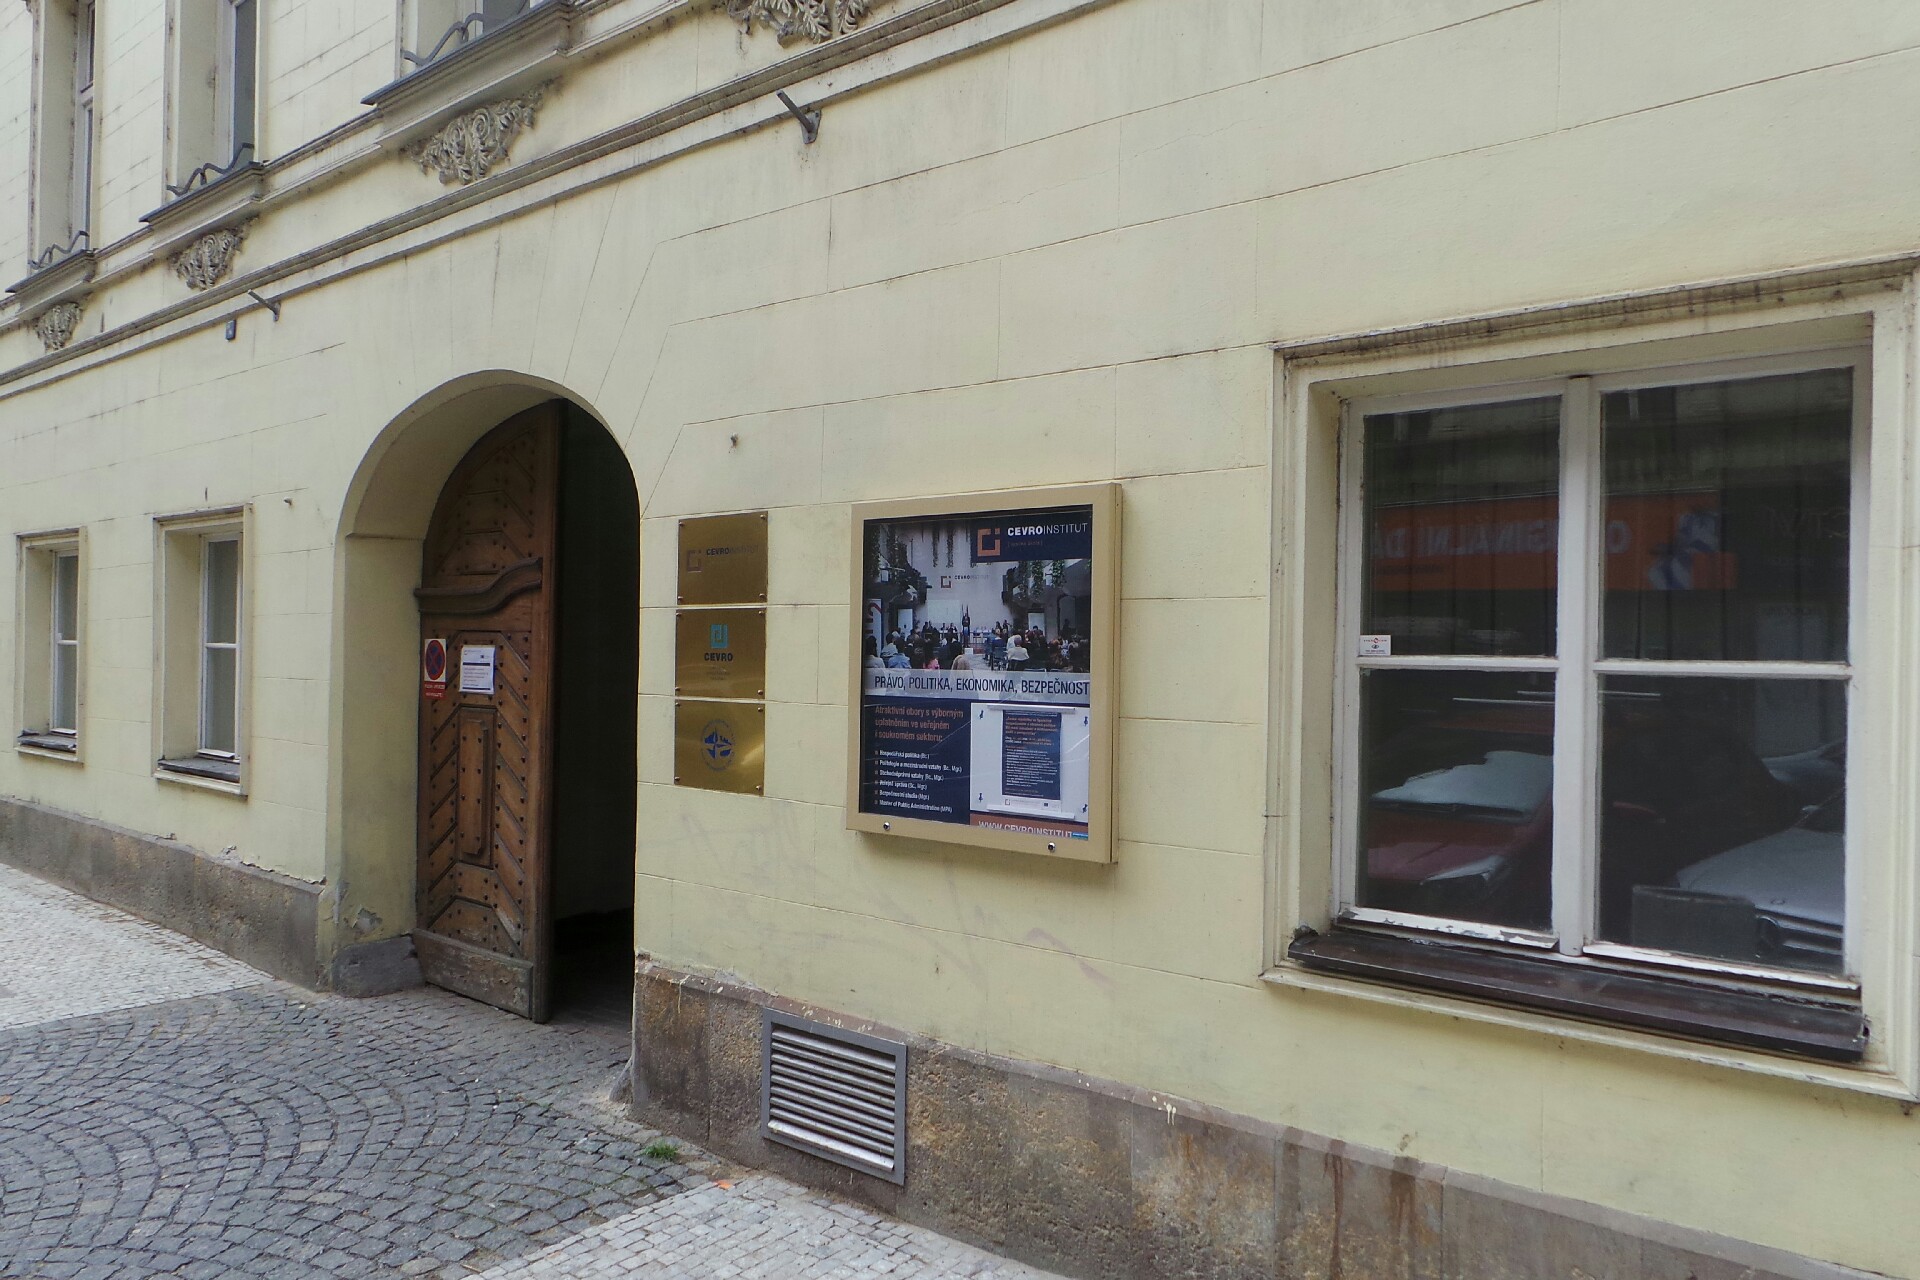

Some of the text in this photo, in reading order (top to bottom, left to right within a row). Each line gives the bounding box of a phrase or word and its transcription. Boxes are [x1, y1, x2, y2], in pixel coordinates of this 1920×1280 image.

[1007, 522, 1088, 536] CEVROINSTITUT
[704, 652, 733, 662] CEVRO
[874, 674, 1089, 695] PRÁVO, POLITIKA, EKONOMIKA, BEZPEČNOST
